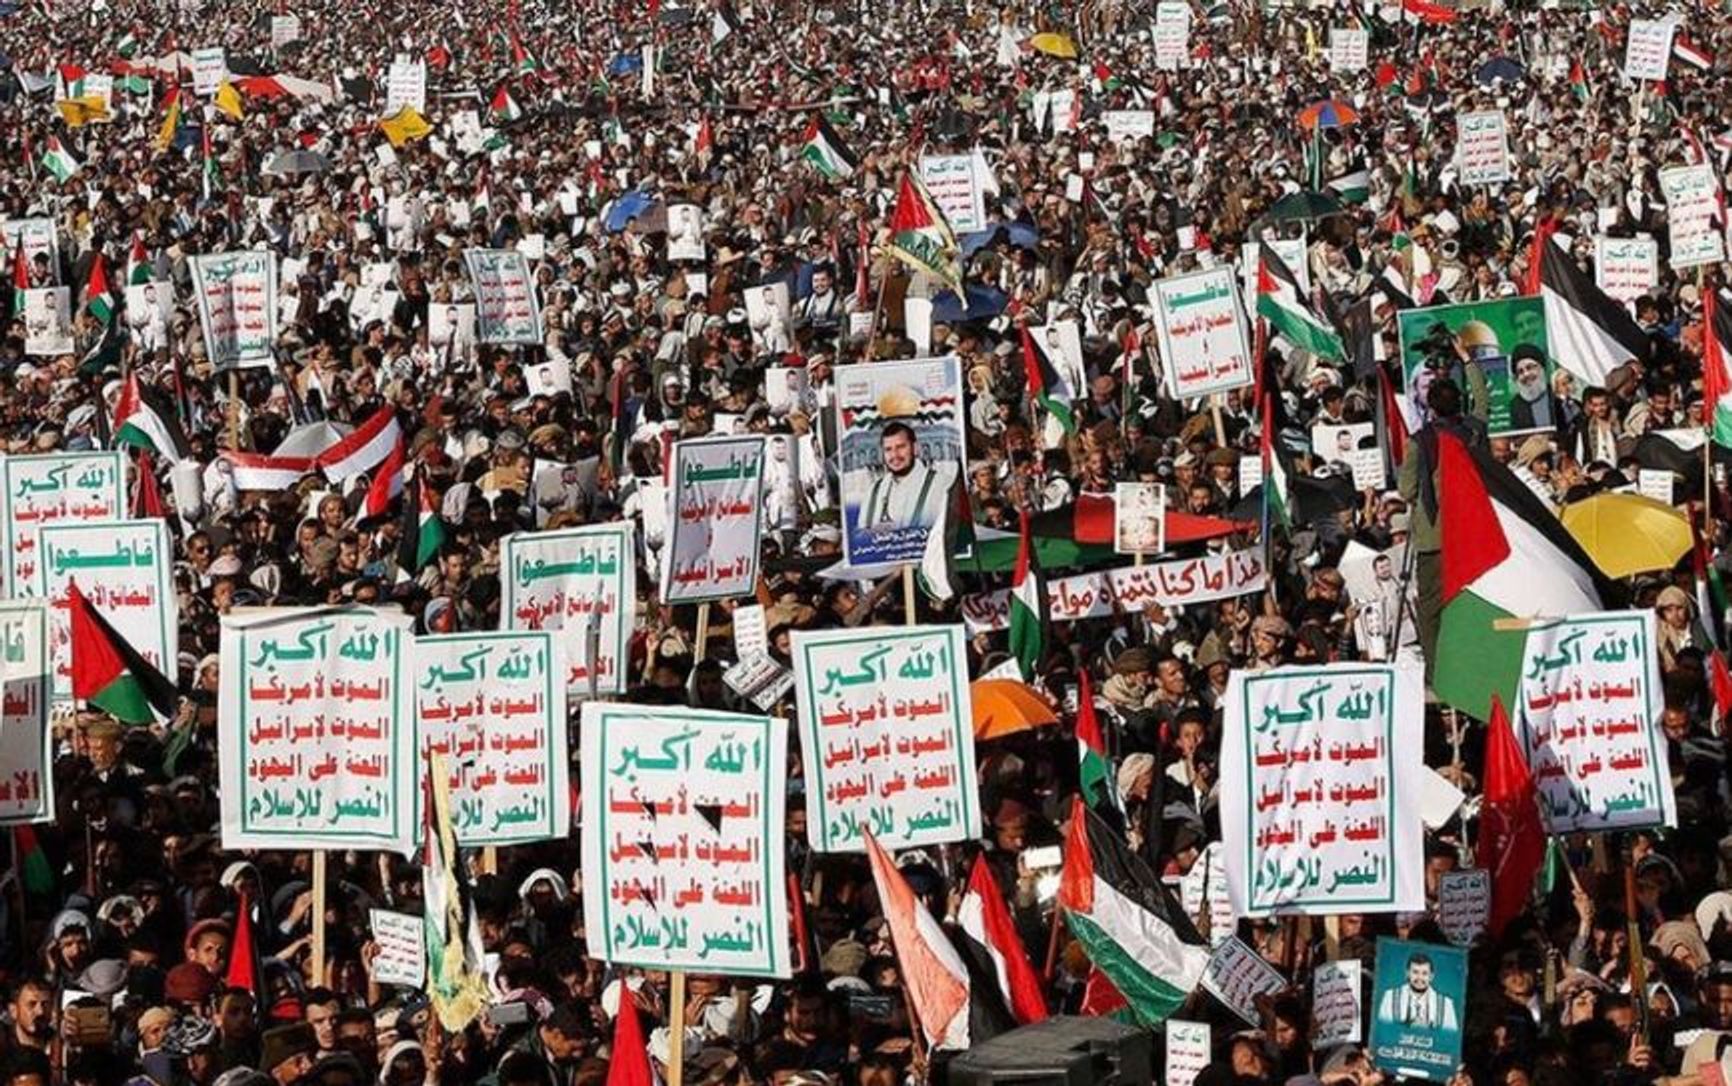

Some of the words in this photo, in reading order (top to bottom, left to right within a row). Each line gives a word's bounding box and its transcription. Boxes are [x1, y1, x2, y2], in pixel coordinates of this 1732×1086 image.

[16, 463, 73, 500] أكبر
[77, 463, 113, 489] الله
[49, 538, 153, 575] قاطعوا
[516, 547, 616, 587] قاطعوا
[1228, 554, 1262, 586] هذا
[1161, 558, 1197, 597] كنا
[1202, 560, 1223, 591] ما
[249, 620, 336, 672] أكبر
[340, 624, 392, 661] الله
[1527, 627, 1587, 682] أكبر
[1593, 631, 1640, 662] الله
[420, 643, 493, 693] أكبر
[497, 648, 544, 679] الله
[818, 643, 893, 698] أكبر
[900, 643, 948, 679] الله
[250, 670, 324, 706] لأمريكا
[331, 677, 389, 703] الموت
[1337, 681, 1385, 719] الله
[1589, 677, 1641, 703] الموت
[421, 690, 484, 723] لأمريكا
[491, 692, 543, 718] الموت
[820, 692, 888, 729] لأمريكا
[894, 691, 950, 721] الموت
[1255, 679, 1332, 736] أكبر
[249, 714, 324, 745] لإسرائيل
[331, 717, 389, 741] الموت
[491, 728, 544, 754] الموت
[897, 728, 954, 758] الموت
[1592, 714, 1643, 740] الموت
[309, 753, 338, 780] على
[346, 750, 389, 778] اللعنة
[609, 725, 702, 782] أكبر
[705, 731, 761, 773] الله
[825, 733, 891, 769] لإسرائيل
[1256, 732, 1322, 769] لأمريكا
[1329, 736, 1385, 766] الموت
[1577, 752, 1601, 780] على
[1610, 749, 1649, 771] اللعنة
[249, 753, 302, 782] اليهود
[471, 765, 497, 792] على
[505, 762, 545, 785] اللعنة
[913, 764, 957, 790] اللعنة
[827, 773, 875, 805] اليهود
[880, 771, 906, 798] على
[1330, 776, 1385, 807] الموت
[1602, 778, 1653, 821] النصر
[250, 788, 322, 827] للإسلام
[328, 785, 389, 825] النصر
[491, 793, 546, 832] النصر
[903, 798, 960, 840] النصر
[1310, 819, 1336, 848] على
[1344, 816, 1386, 841] اللعنة
[695, 837, 759, 867] الموت
[1325, 850, 1387, 894] النصر
[674, 877, 703, 909] على
[713, 876, 760, 908] اللعنة
[614, 914, 688, 959] للإسلام
[698, 915, 764, 958] النصر
